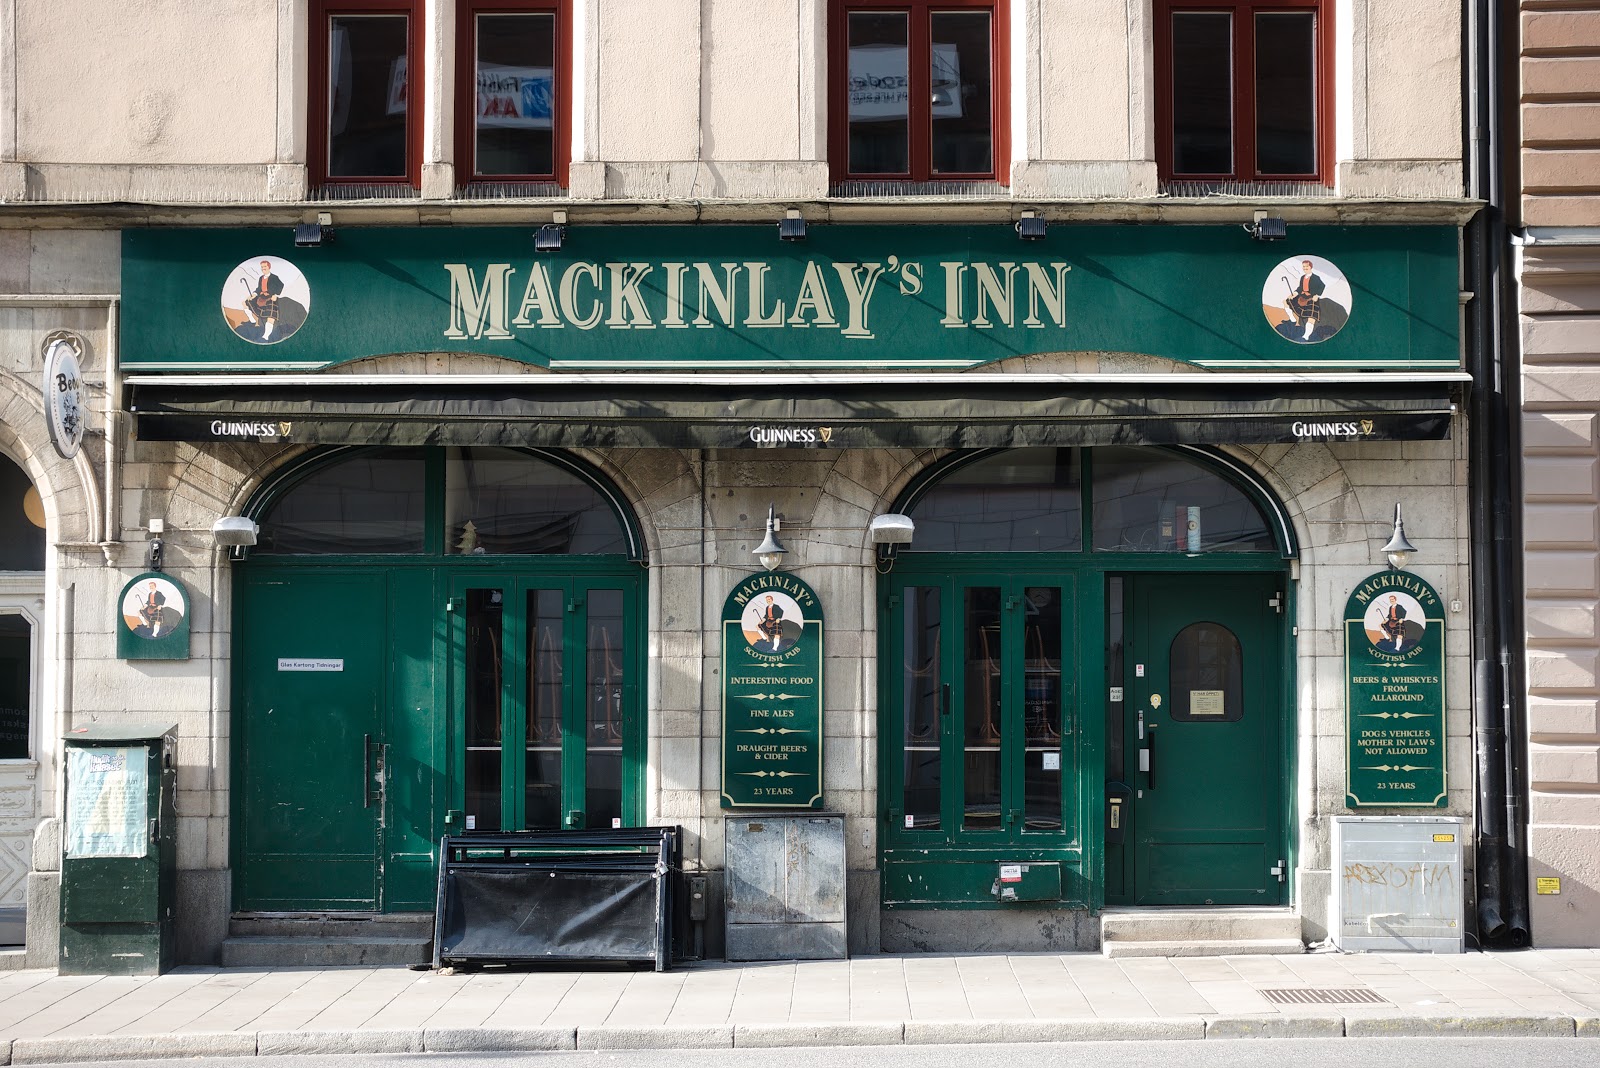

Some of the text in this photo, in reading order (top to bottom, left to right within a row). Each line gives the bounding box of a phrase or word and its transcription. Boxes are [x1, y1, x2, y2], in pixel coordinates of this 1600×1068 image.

[940, 262, 1071, 328] INN
[211, 420, 275, 437] GUINNESS
[750, 426, 815, 442] GUINNESS
[1292, 421, 1357, 437] GUINNESS
[744, 646, 801, 662] SCOTTISH PUB
[1407, 646, 1424, 659] PUB
[731, 677, 814, 685] INTERESTING FOOD
[1353, 676, 1438, 684] BEERS & WHISKYES
[1383, 685, 1408, 693] FROM
[1361, 730, 1387, 738] DOGS
